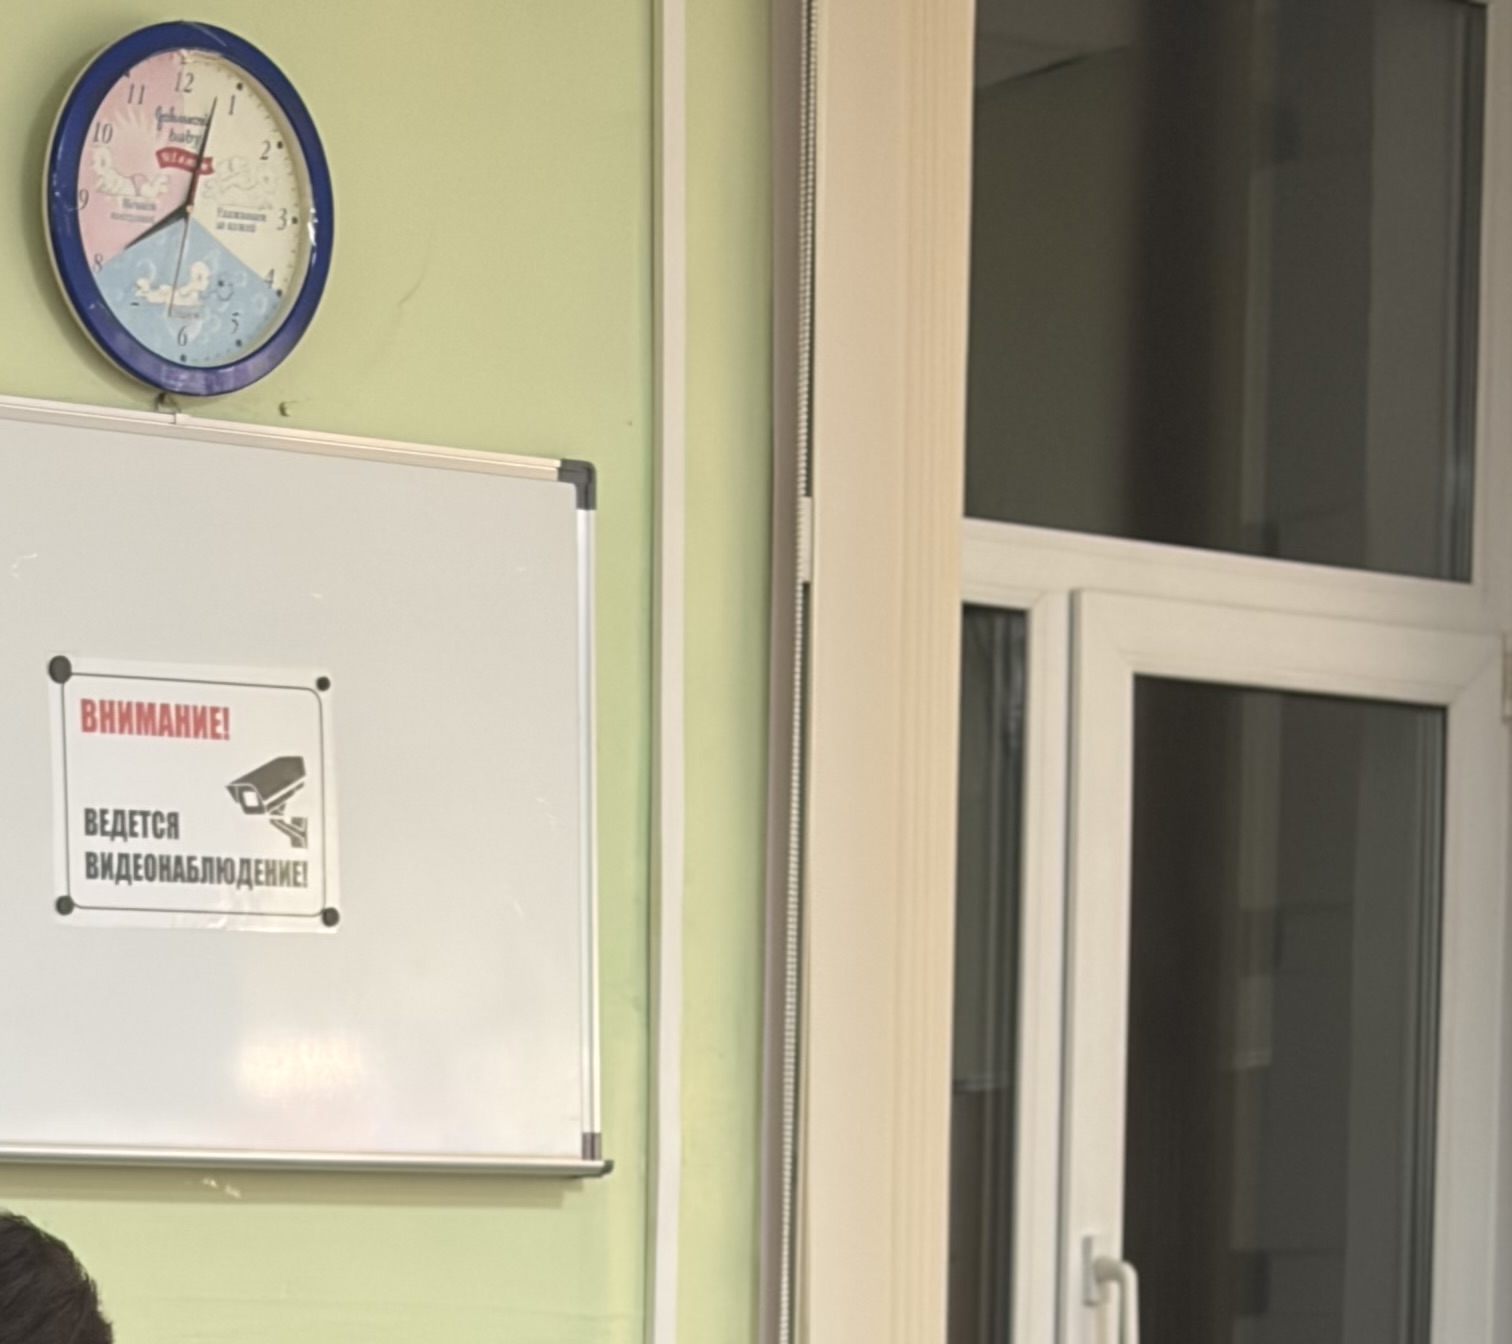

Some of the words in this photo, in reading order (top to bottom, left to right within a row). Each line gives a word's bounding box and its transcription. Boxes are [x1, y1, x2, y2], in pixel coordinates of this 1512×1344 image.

[173, 71, 194, 94] 12
[127, 83, 145, 105] 11
[228, 94, 236, 115] 1
[92, 121, 113, 144] 10
[259, 139, 271, 160] 2
[79, 188, 89, 210] 9
[276, 207, 287, 230] 3
[93, 254, 103, 274] 8
[263, 268, 275, 290] 4
[231, 312, 240, 333] 5
[177, 325, 187, 347] 6
[79, 698, 231, 741] ВНИМАНИЕ!
[84, 808, 180, 842] ВЕДЕТСЯ
[84, 851, 309, 890] ВИДЕОНАБЛЮДЕНИЕ!
